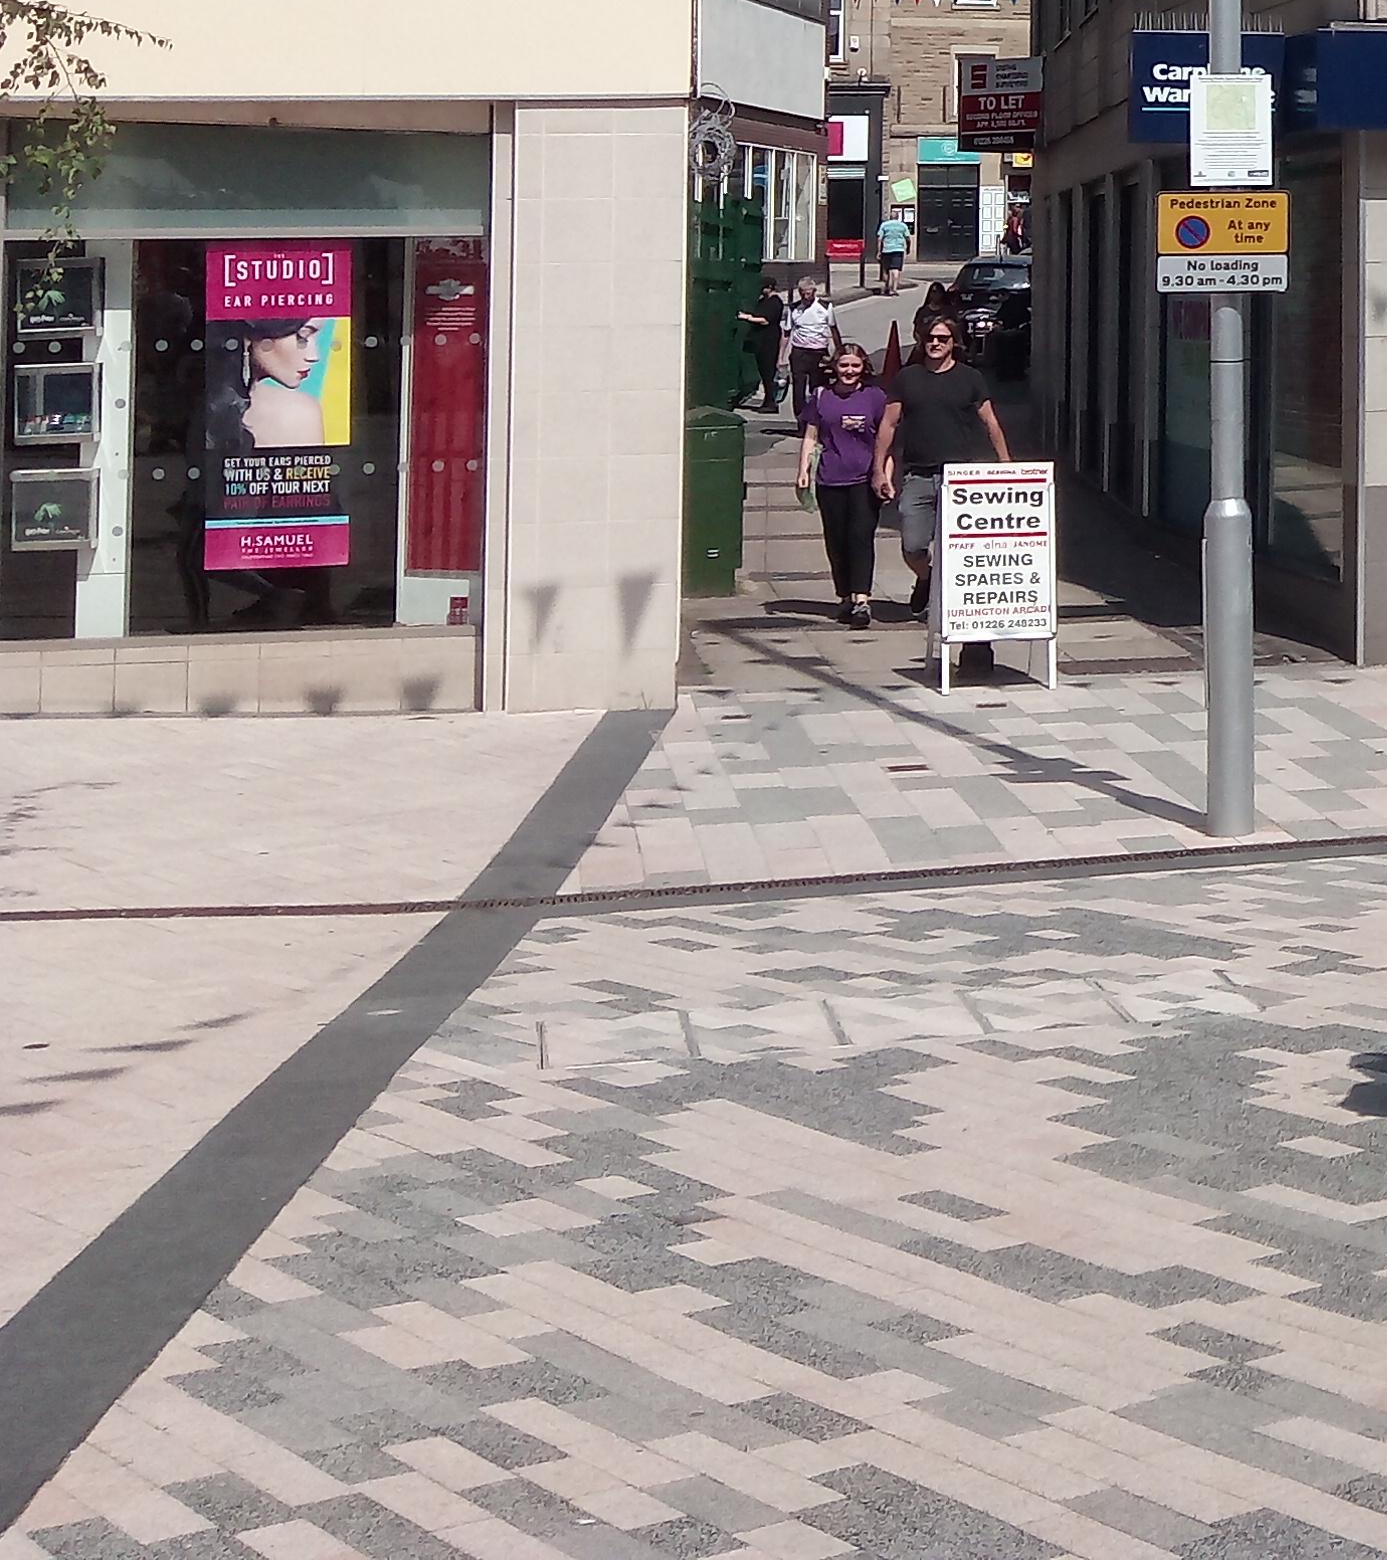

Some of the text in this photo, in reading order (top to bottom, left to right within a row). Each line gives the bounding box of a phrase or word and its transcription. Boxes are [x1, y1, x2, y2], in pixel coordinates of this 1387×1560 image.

[978, 95, 1025, 110] TO LET
[1170, 198, 1277, 209] Pedestrian Zone
[1228, 220, 1271, 232] At any
[1234, 233, 1264, 243] time
[1187, 260, 1259, 272] No loading
[1162, 275, 1194, 287] 9.30
[1197, 277, 1216, 286] am
[1226, 274, 1260, 286] 4.30
[1262, 276, 1283, 287] pm
[224, 294, 334, 308] EAR PIERCING
[224, 455, 331, 468] GET YOUR EARS PIERCED
[224, 467, 331, 481] WITH US & RECEIVE
[225, 480, 331, 495] 10% OFF YOUR NEXT
[952, 487, 1044, 508] Sewing
[956, 513, 1041, 531] Centre
[240, 533, 314, 547] H.SAMUEL
[949, 542, 976, 550] PFAFF
[1013, 540, 1048, 549] JANOME
[963, 553, 1034, 568] SEWING
[955, 571, 1041, 587] SPARES &
[963, 590, 1039, 605] REPAIRS
[948, 607, 1010, 618] URLINGTON
[949, 621, 969, 631] Tel:
[972, 620, 1006, 630] 01226
